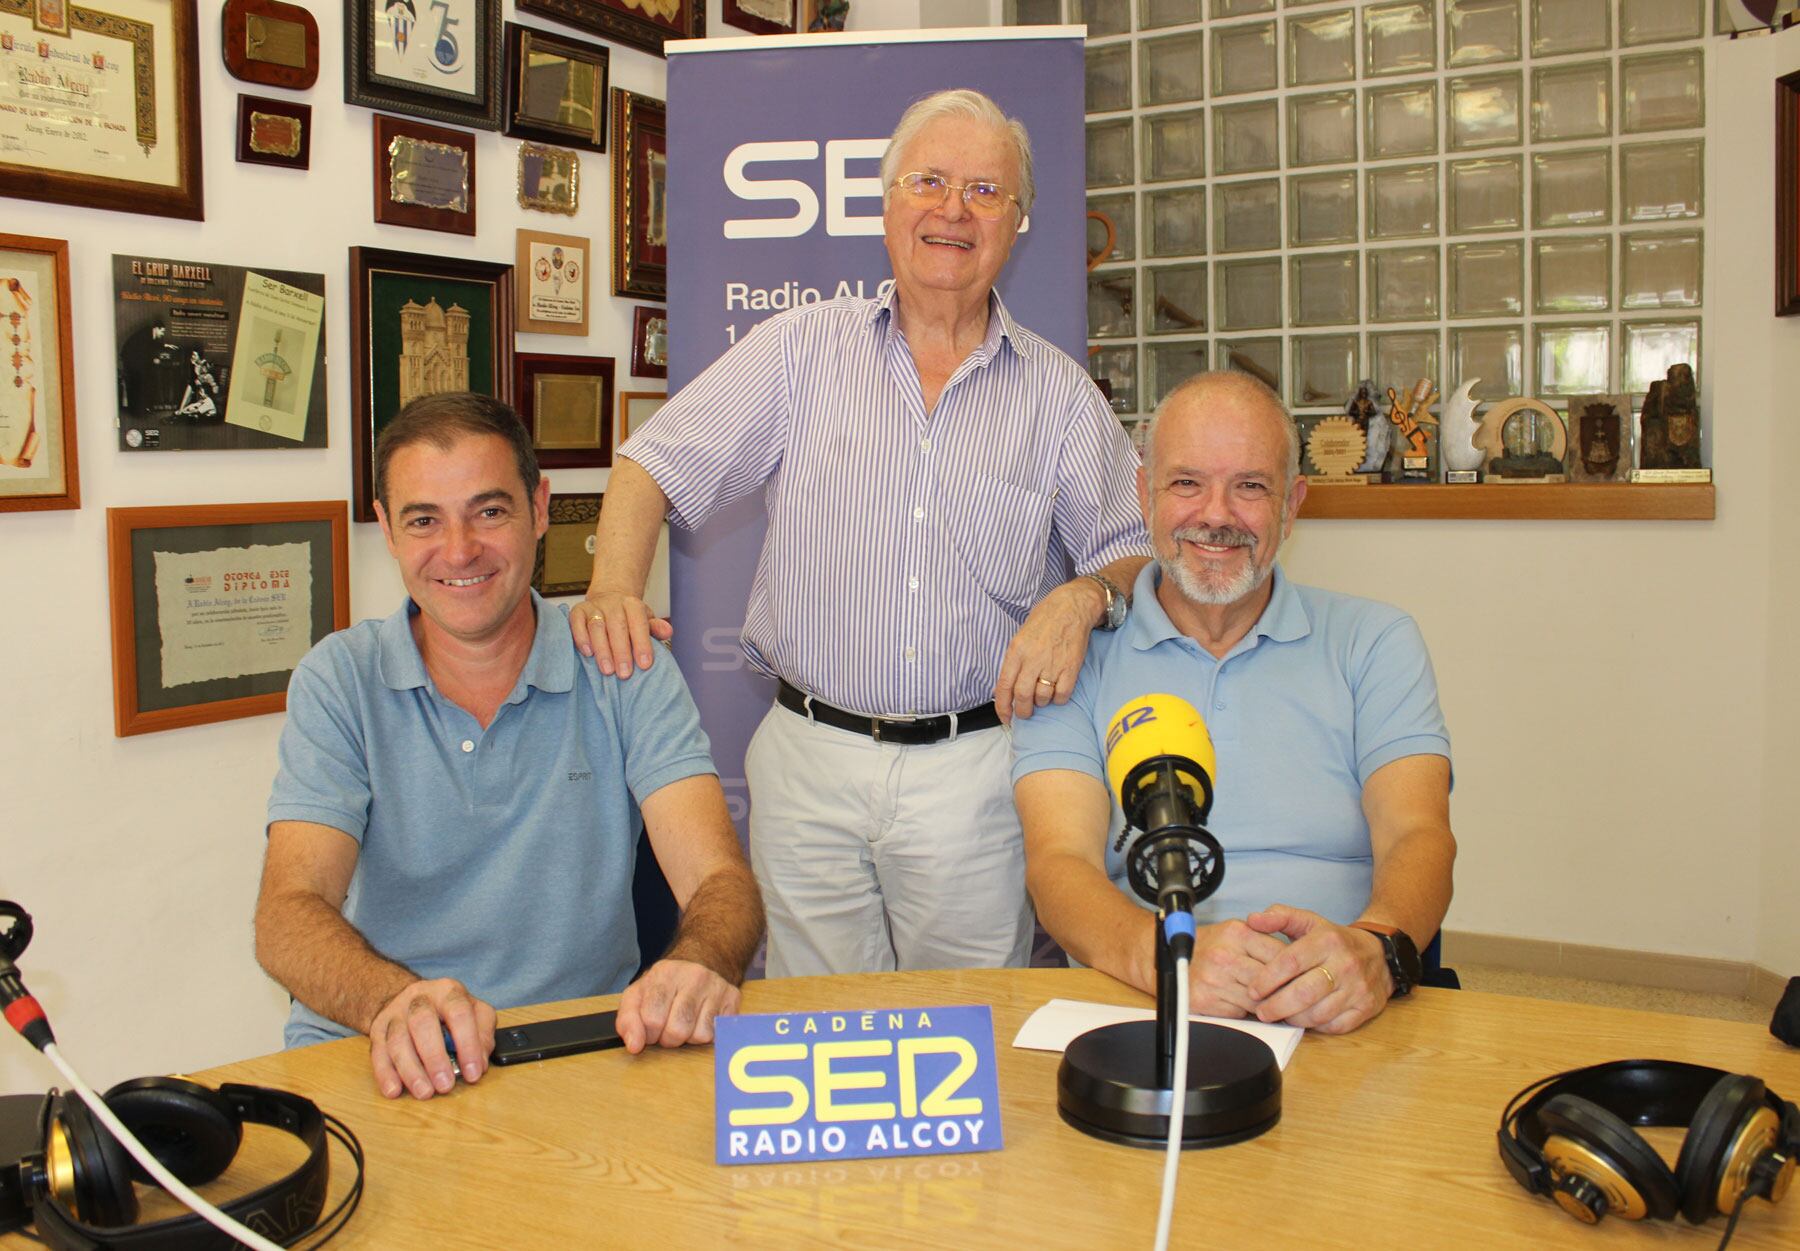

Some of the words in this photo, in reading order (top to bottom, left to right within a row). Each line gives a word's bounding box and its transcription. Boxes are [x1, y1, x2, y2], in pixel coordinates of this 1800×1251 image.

[131, 260, 143, 275] EL
[146, 261, 169, 277] GRUP
[172, 263, 212, 281] BARXELL
[262, 279, 278, 291] Ser
[726, 281, 821, 311] Radio
[775, 1012, 932, 1035] CADENA
[728, 1036, 983, 1127] SER
[729, 1126, 847, 1157] RADIO
[866, 1119, 984, 1151] ALCOY
